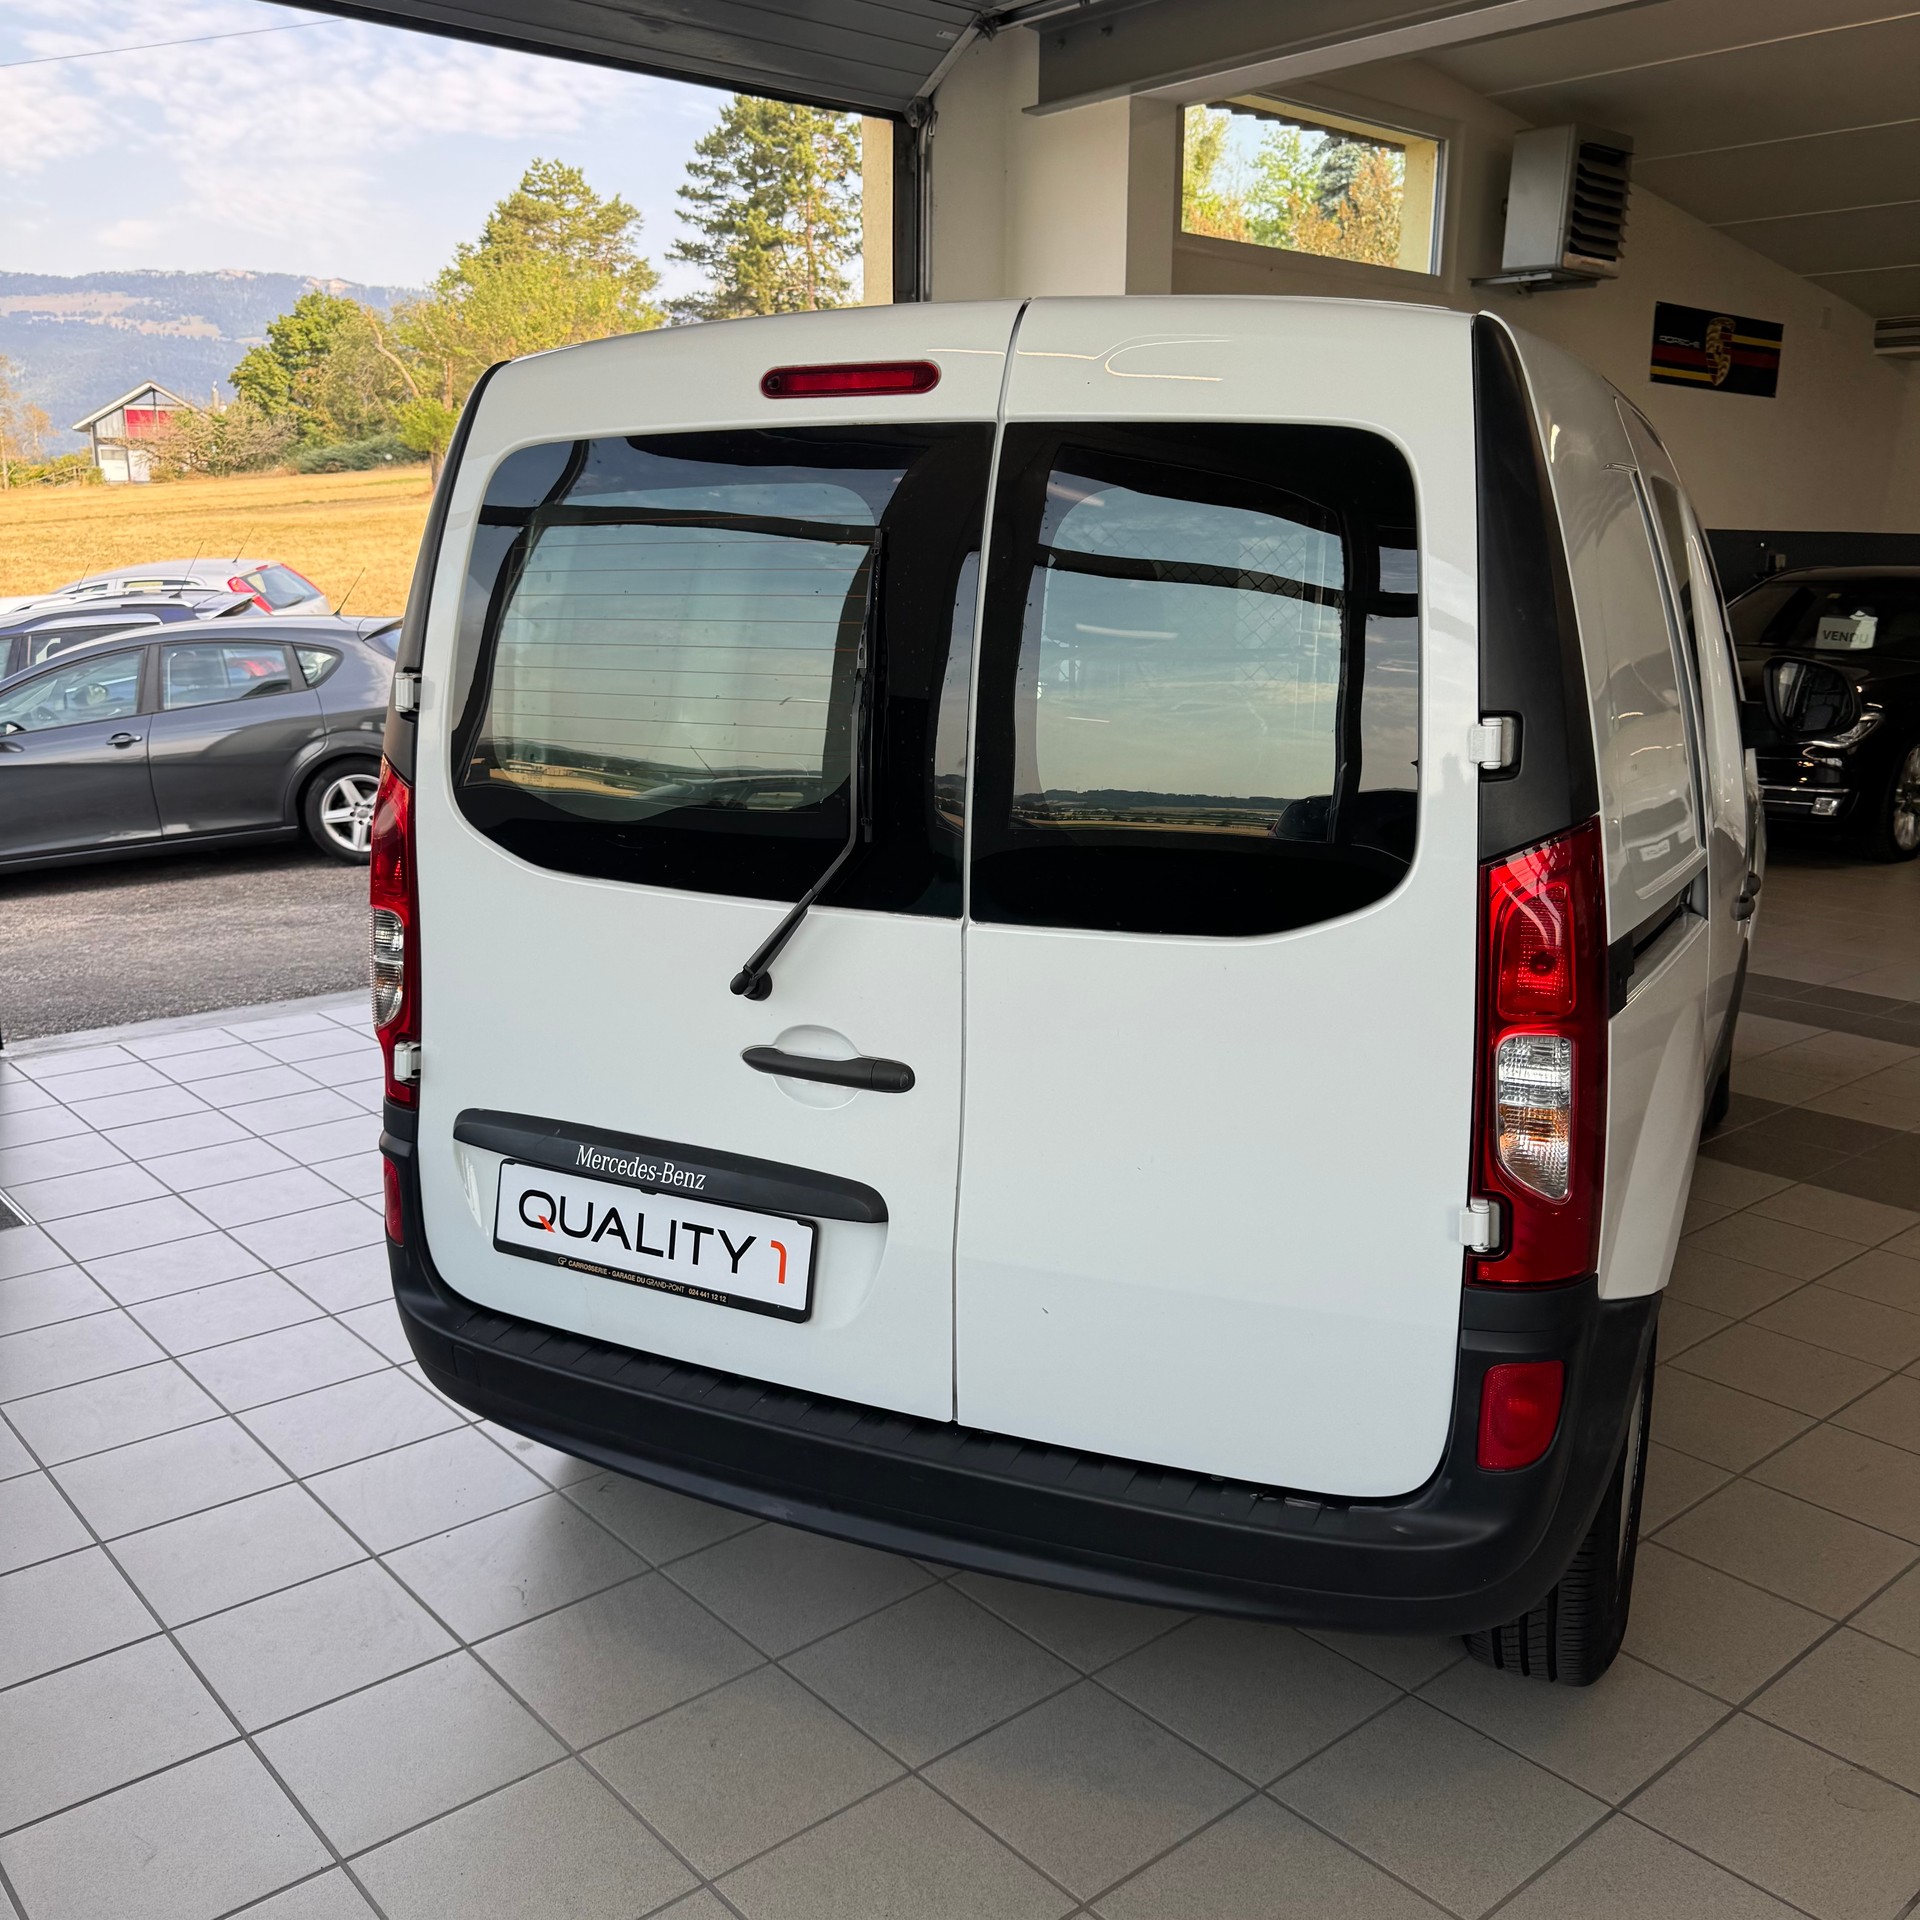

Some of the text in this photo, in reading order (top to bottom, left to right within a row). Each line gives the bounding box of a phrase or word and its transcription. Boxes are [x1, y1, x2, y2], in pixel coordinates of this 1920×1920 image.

[575, 1144, 707, 1190] Mercedes-Benz
[518, 1189, 788, 1284] QUALITY 1
[568, 1259, 608, 1275] CARROSSERIE
[611, 1270, 636, 1282] GARAGE
[636, 1276, 646, 1284] DU
[645, 1278, 685, 1293] GRAND-PONT
[688, 1288, 699, 1296] 024
[699, 1290, 710, 1299] 441
[711, 1293, 719, 1301] 12
[719, 1295, 727, 1303] 12
